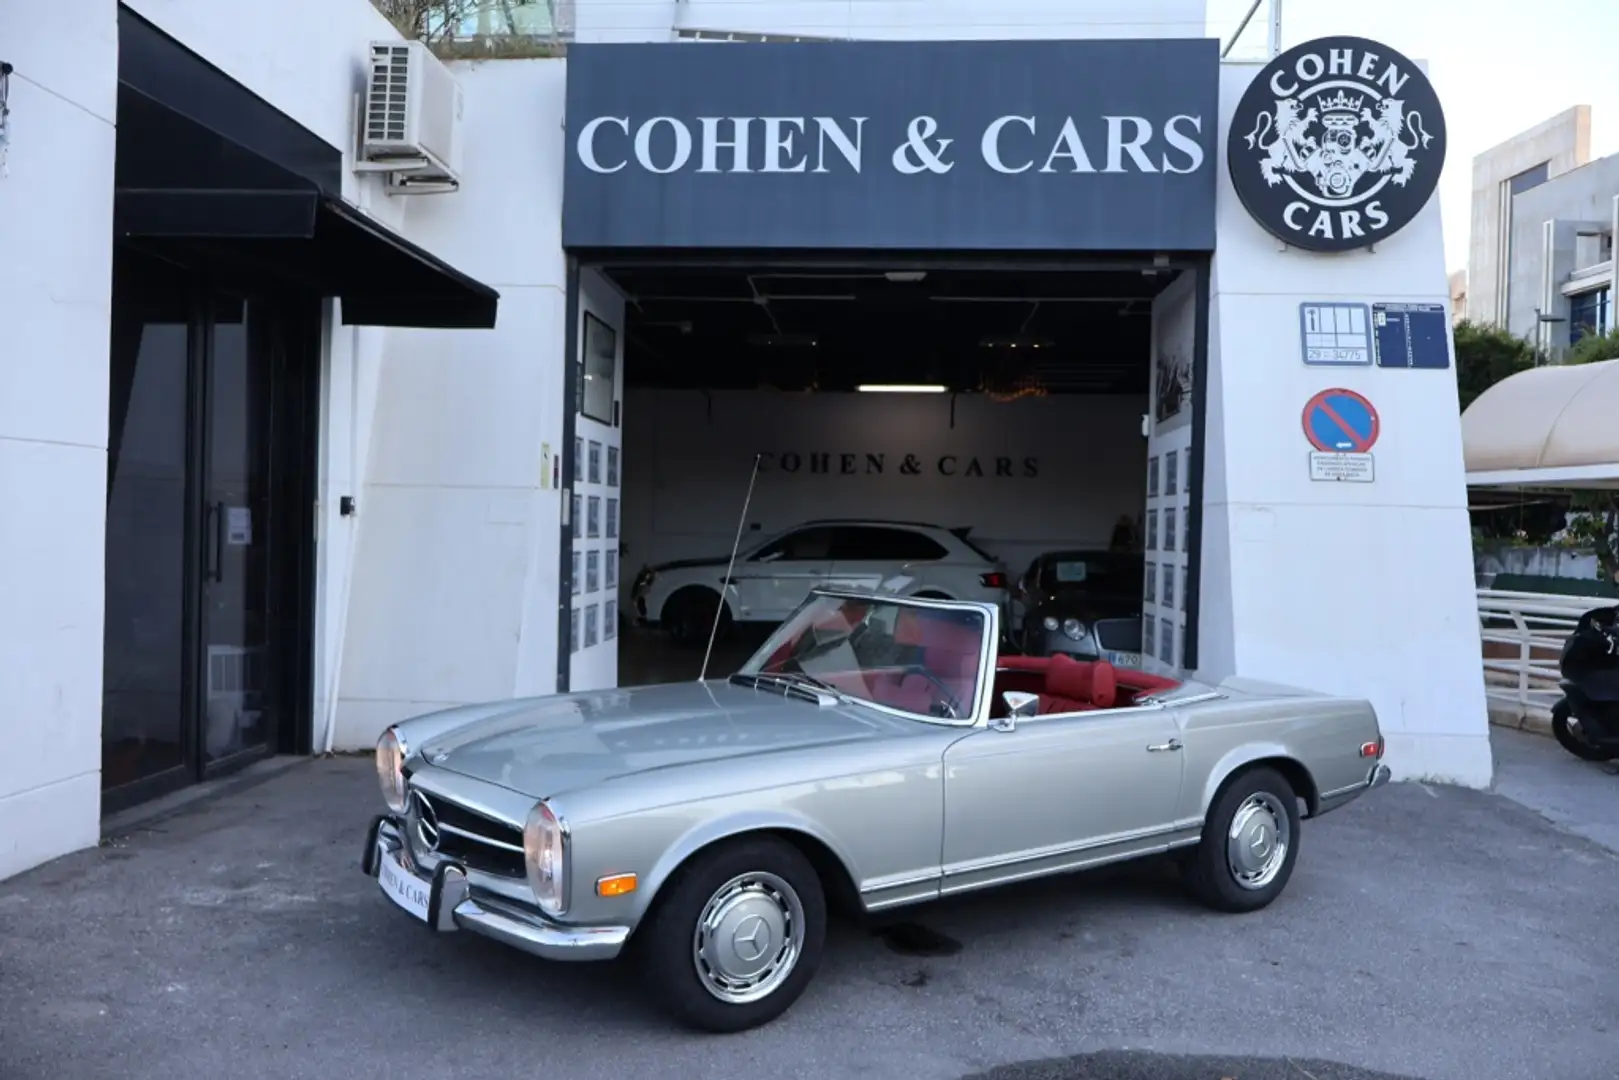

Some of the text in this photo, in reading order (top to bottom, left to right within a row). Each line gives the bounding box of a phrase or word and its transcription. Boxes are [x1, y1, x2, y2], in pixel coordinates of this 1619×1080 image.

[1270, 49, 1410, 97] COHEN
[577, 115, 1205, 174] COHEN & CARS
[1283, 201, 1389, 239] CARS
[756, 451, 1039, 478] COHEN & CARS
